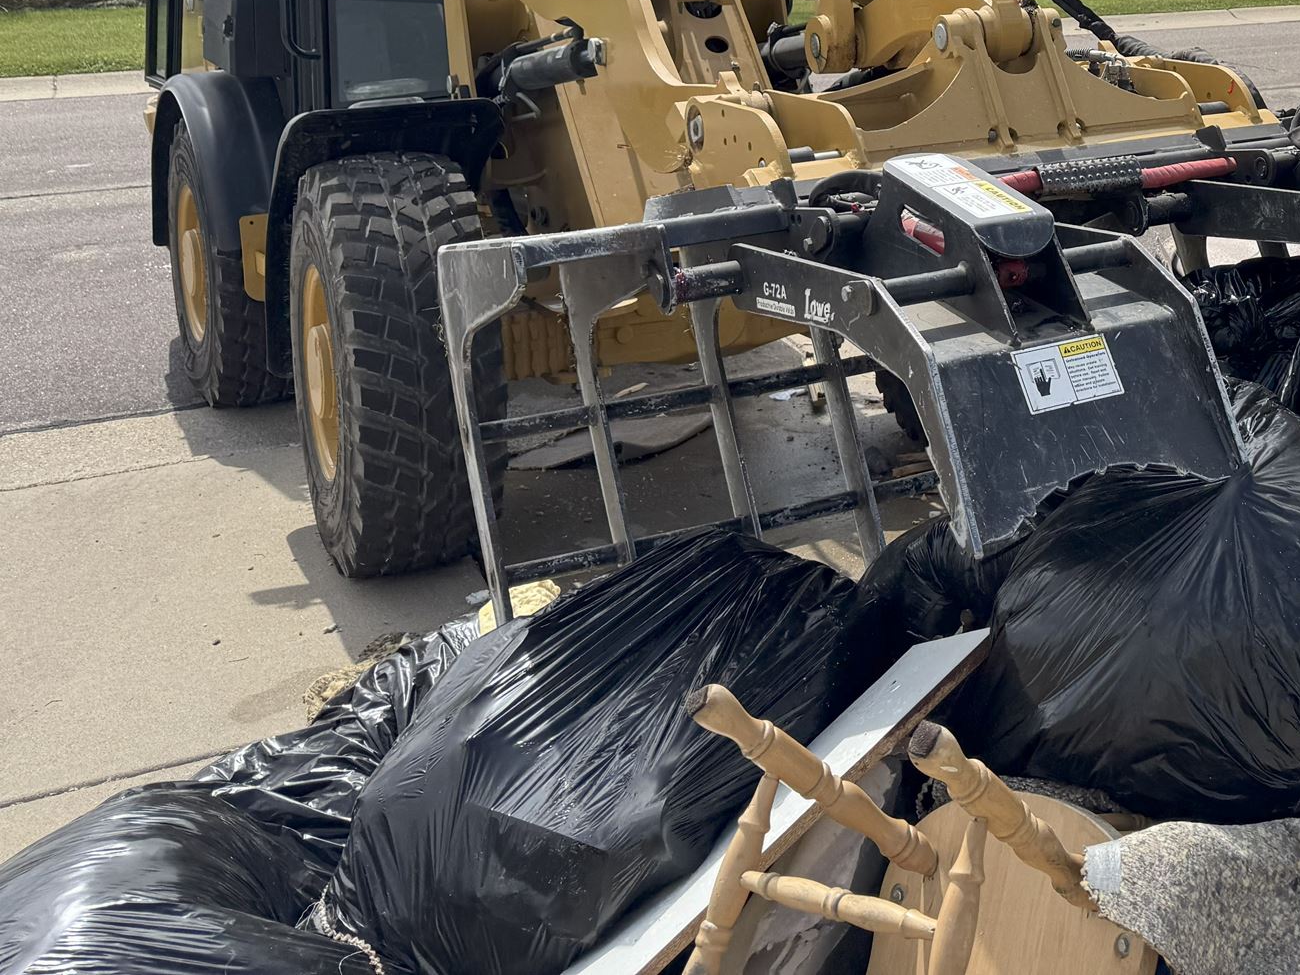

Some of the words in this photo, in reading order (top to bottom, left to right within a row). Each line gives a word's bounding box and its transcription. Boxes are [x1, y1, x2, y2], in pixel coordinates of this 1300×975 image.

[985, 186, 1026, 210] CAUTION
[763, 282, 787, 299] G-72A
[1070, 340, 1101, 353] CAUTION
